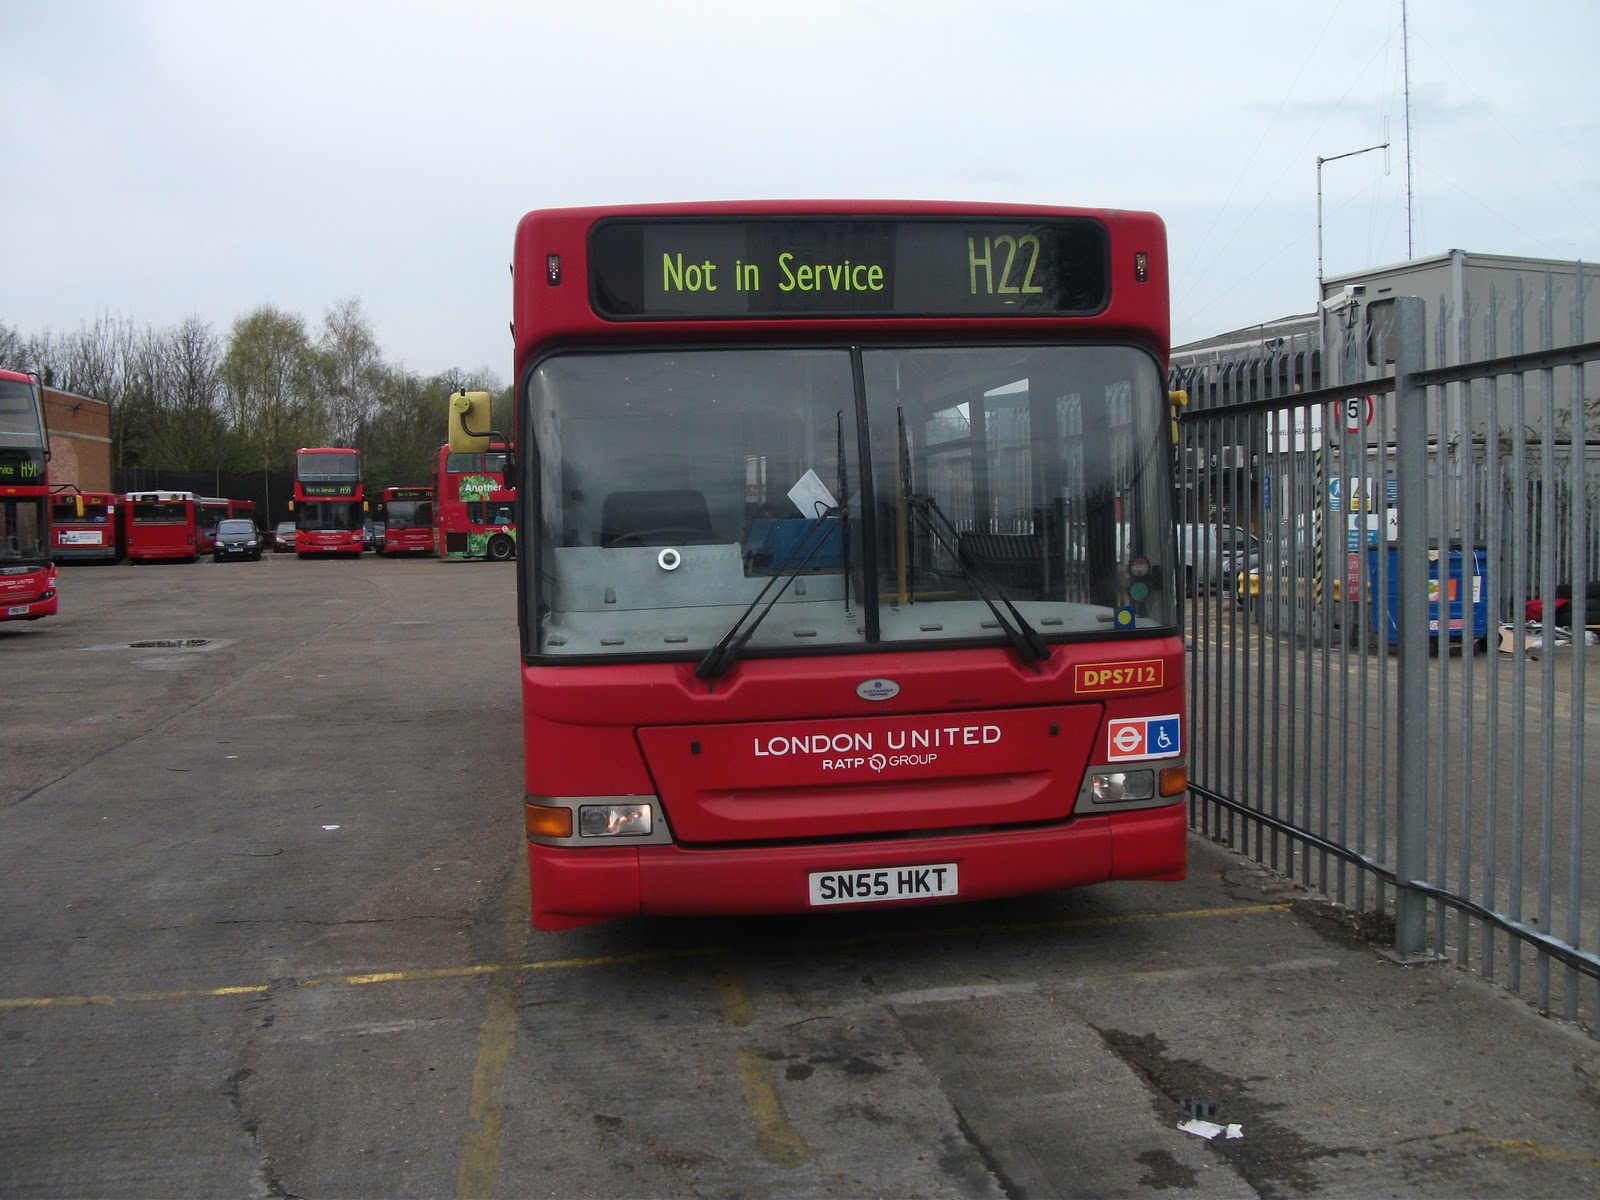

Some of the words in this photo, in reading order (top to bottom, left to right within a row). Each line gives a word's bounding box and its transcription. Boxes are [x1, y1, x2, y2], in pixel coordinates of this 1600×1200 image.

[663, 253, 717, 293] Not
[736, 259, 760, 293] in
[778, 252, 885, 293] Service
[967, 234, 1044, 295] H22
[1347, 400, 1358, 419] 5
[20, 461, 37, 478] H91
[339, 486, 351, 494] H91
[465, 483, 502, 492] Another
[1083, 666, 1156, 687] DPS712
[754, 732, 873, 757] LONDON
[887, 725, 1001, 750] UNITED
[822, 757, 865, 770] RATP
[889, 753, 938, 767] GROUP
[820, 871, 889, 900] SN55
[897, 867, 948, 894] HKT
